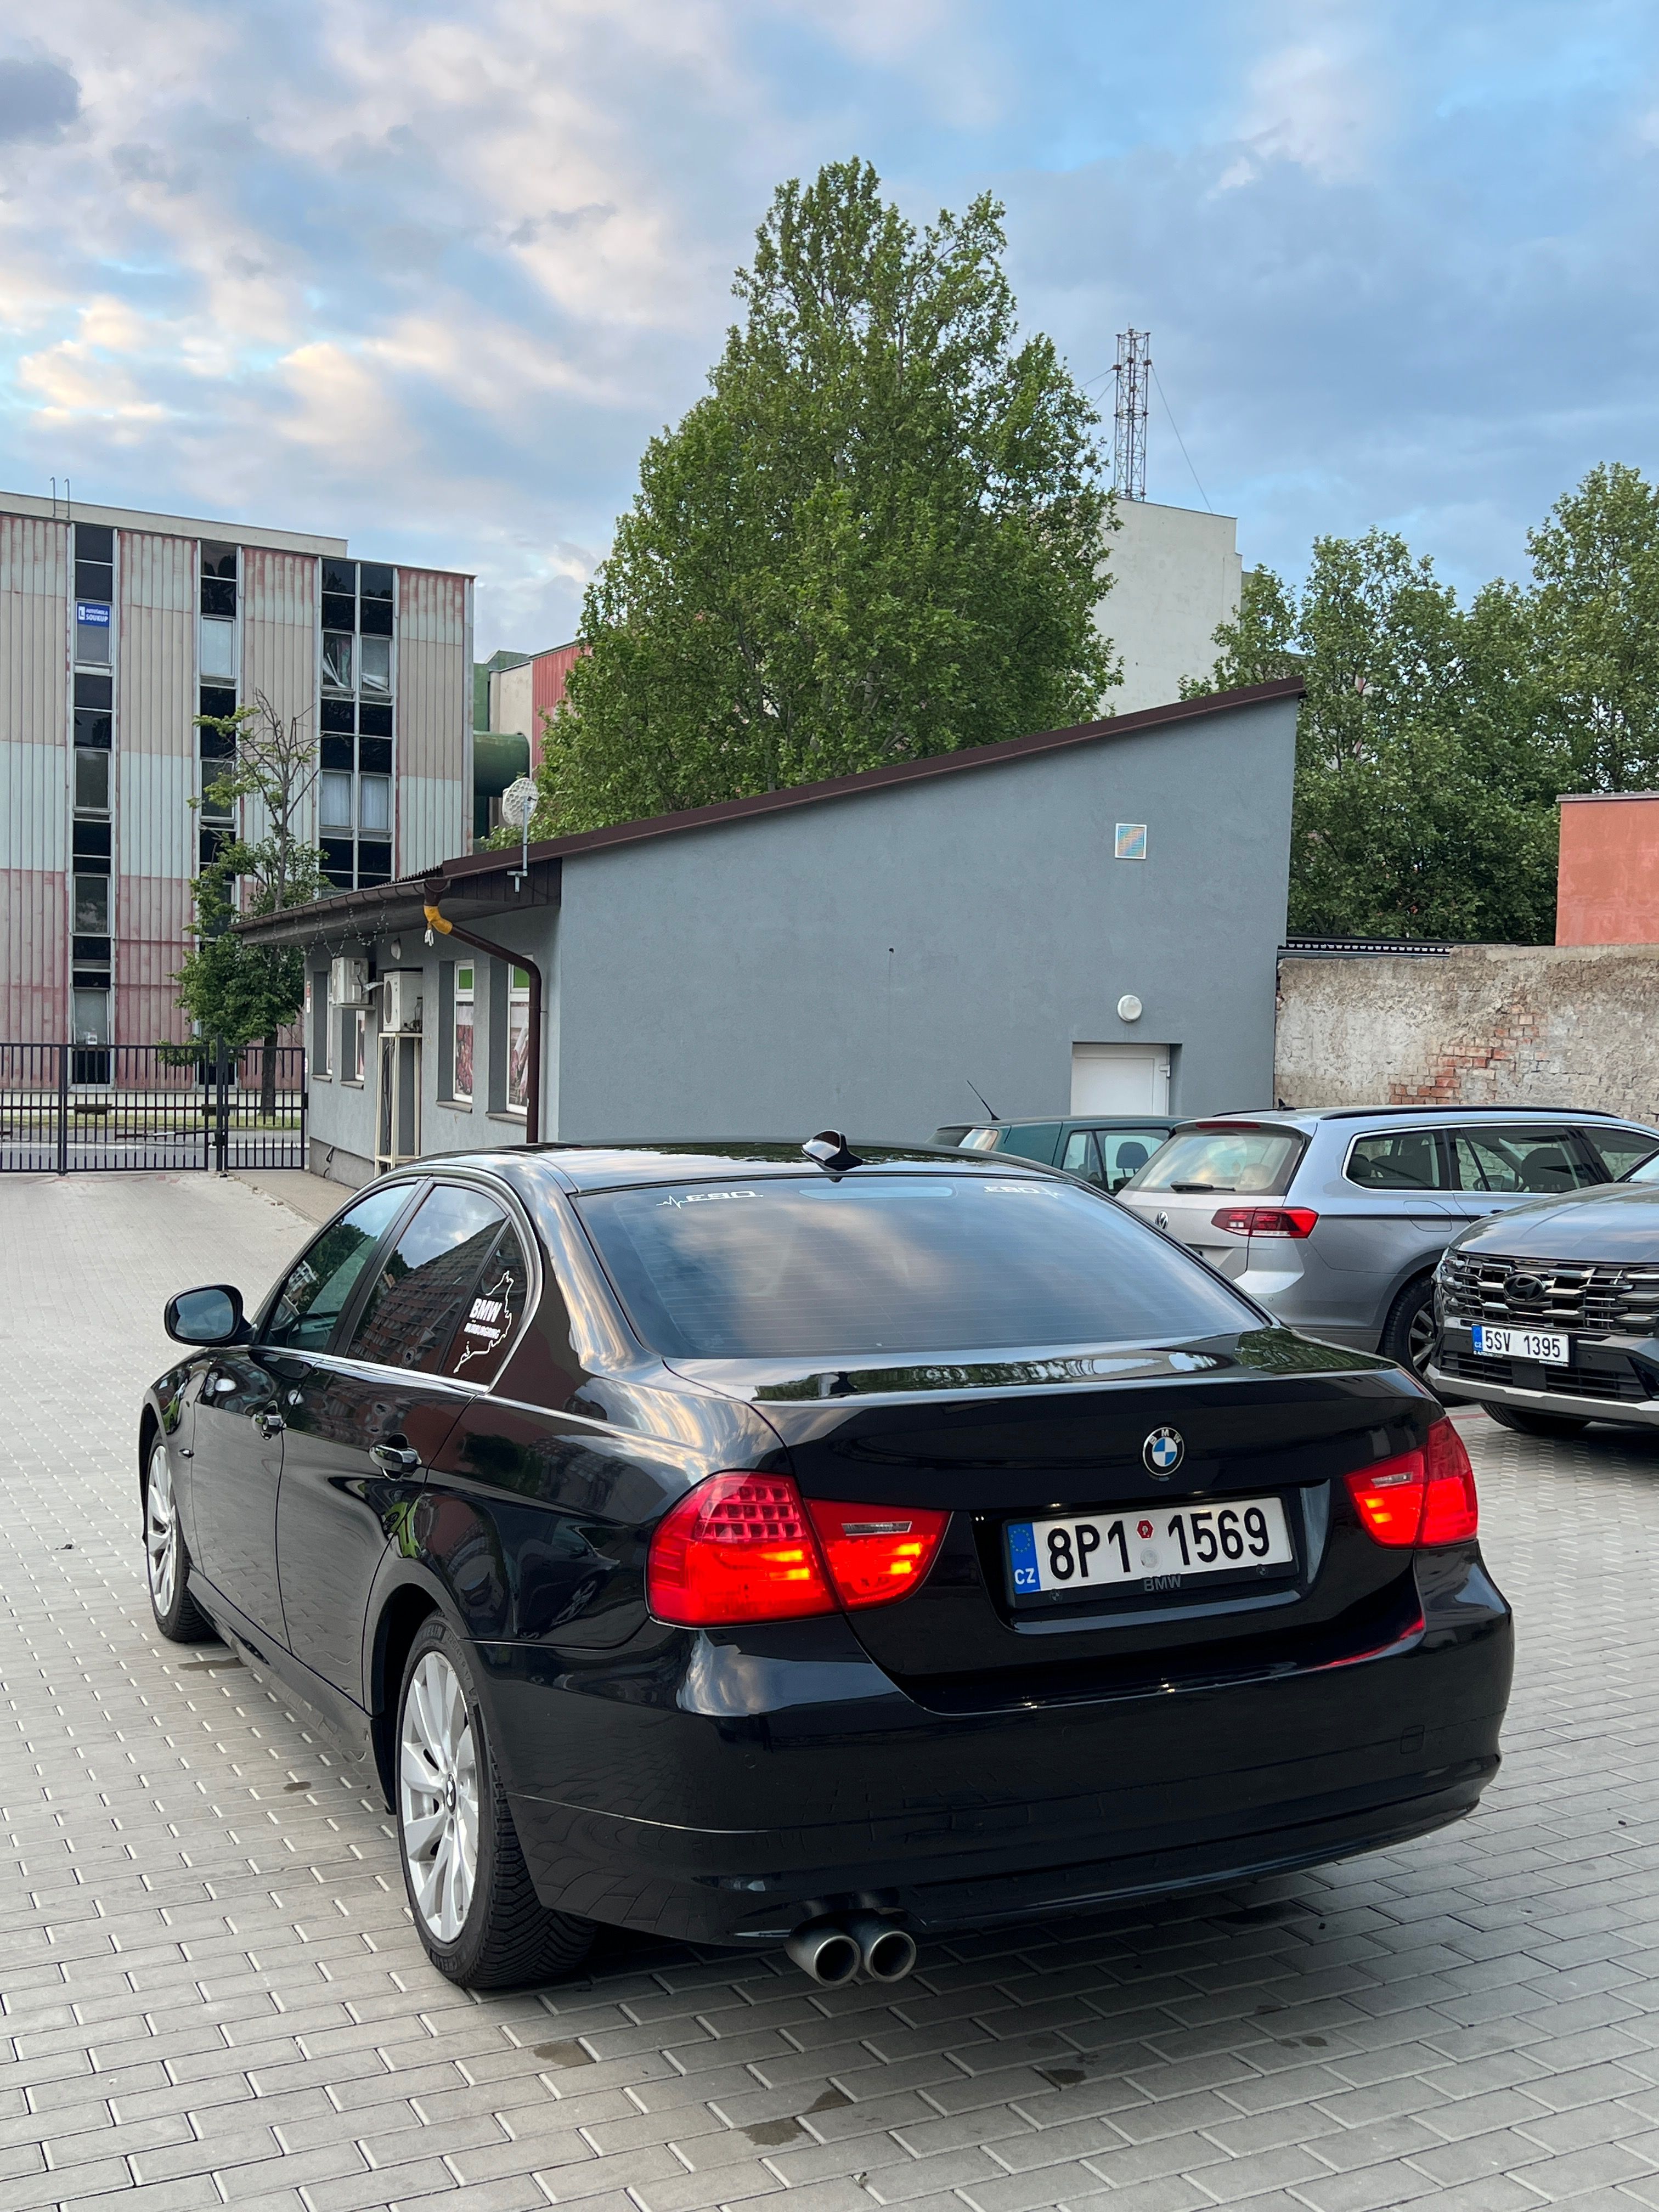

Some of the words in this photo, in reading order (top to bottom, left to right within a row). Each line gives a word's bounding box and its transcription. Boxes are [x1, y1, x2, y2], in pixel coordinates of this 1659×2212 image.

[469, 1298, 503, 1322] BMW
[1485, 1330, 1510, 1352] 5SV
[1523, 1335, 1560, 1358] 1395
[1148, 1429, 1182, 1445] BMW
[1047, 1520, 1131, 1581] 8P1
[1167, 1508, 1269, 1566] 1569
[1014, 1568, 1036, 1585] CZ
[1143, 1575, 1182, 1592] BMW
